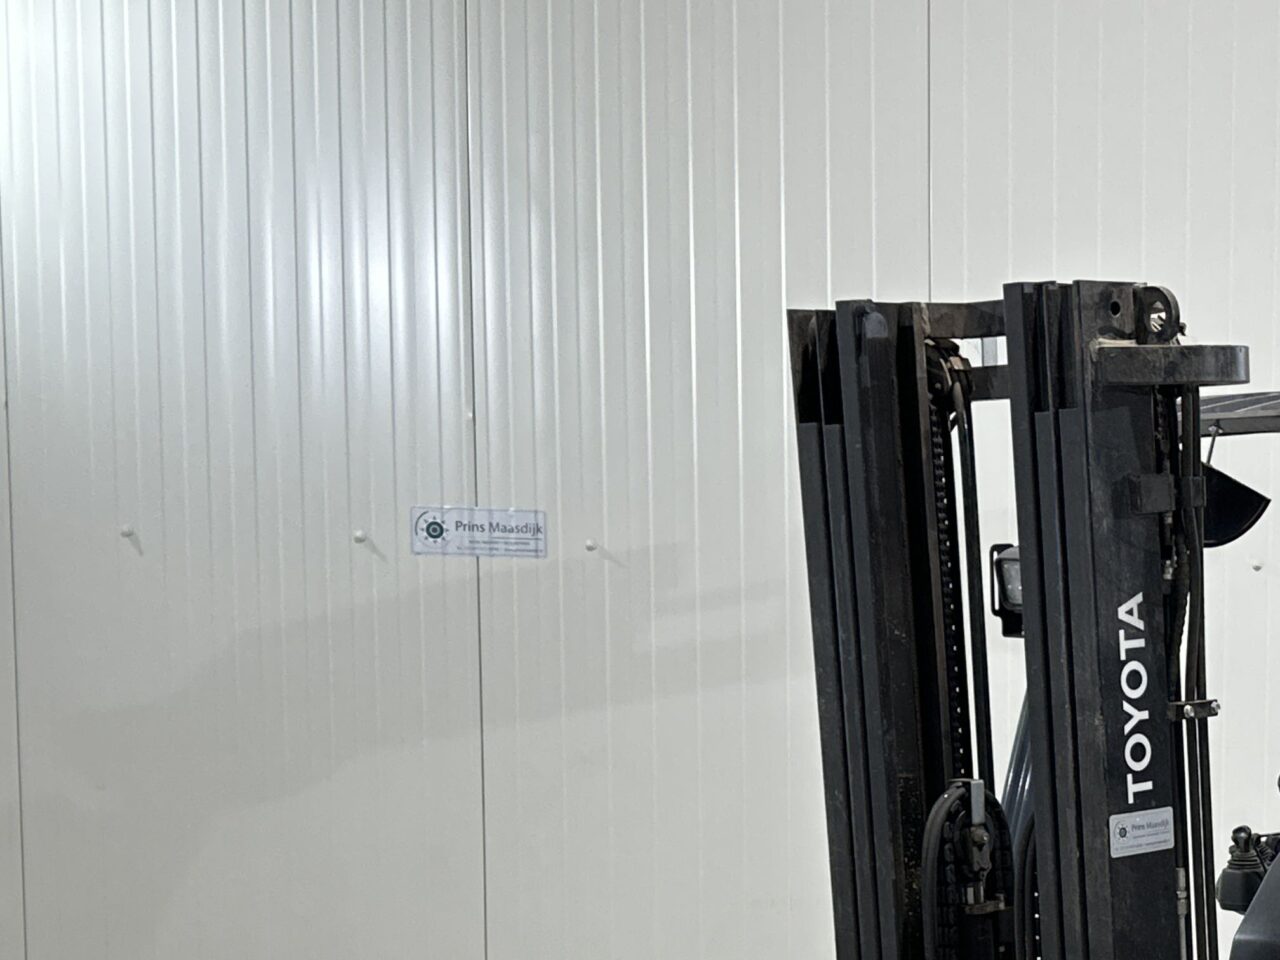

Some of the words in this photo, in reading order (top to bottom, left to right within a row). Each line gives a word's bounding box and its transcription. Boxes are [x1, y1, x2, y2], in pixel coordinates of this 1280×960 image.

[455, 520, 486, 533] Prins
[488, 521, 543, 537] Maasdijk
[1117, 591, 1154, 805] TOYOTA
